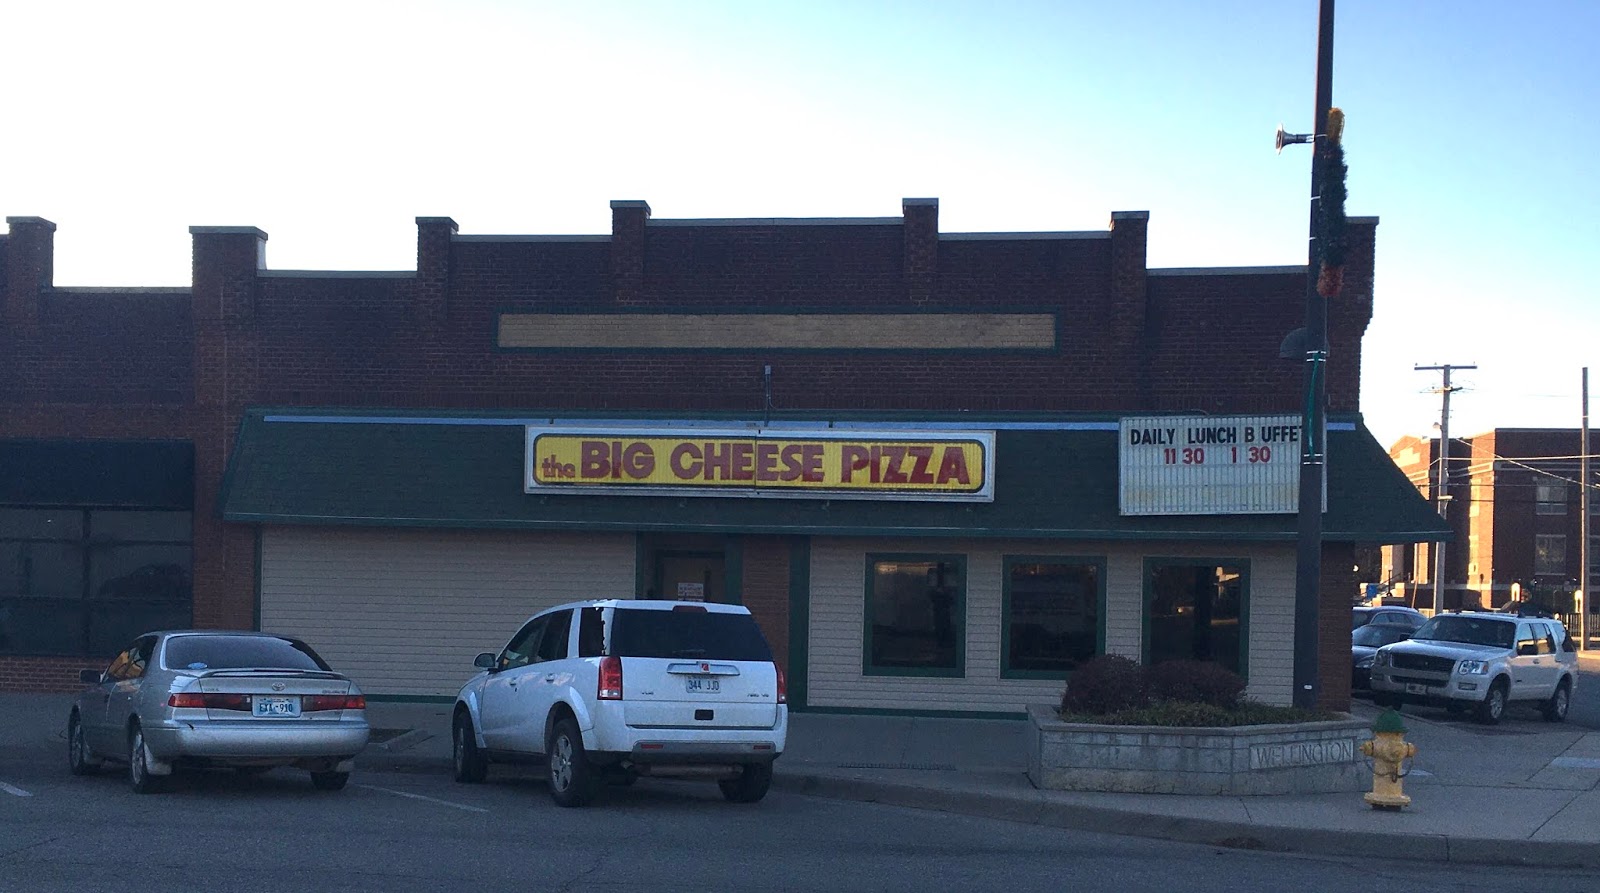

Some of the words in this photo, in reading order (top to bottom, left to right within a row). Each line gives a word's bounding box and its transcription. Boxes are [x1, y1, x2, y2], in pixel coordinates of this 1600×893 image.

[1131, 428, 1175, 445] DAILY
[1187, 426, 1236, 444] LUNCH
[542, 455, 575, 478] the
[581, 441, 655, 480] BIG
[670, 442, 825, 482] CHEESE
[841, 444, 970, 484] PIZZA
[1256, 740, 1353, 765] WELLINGTON
